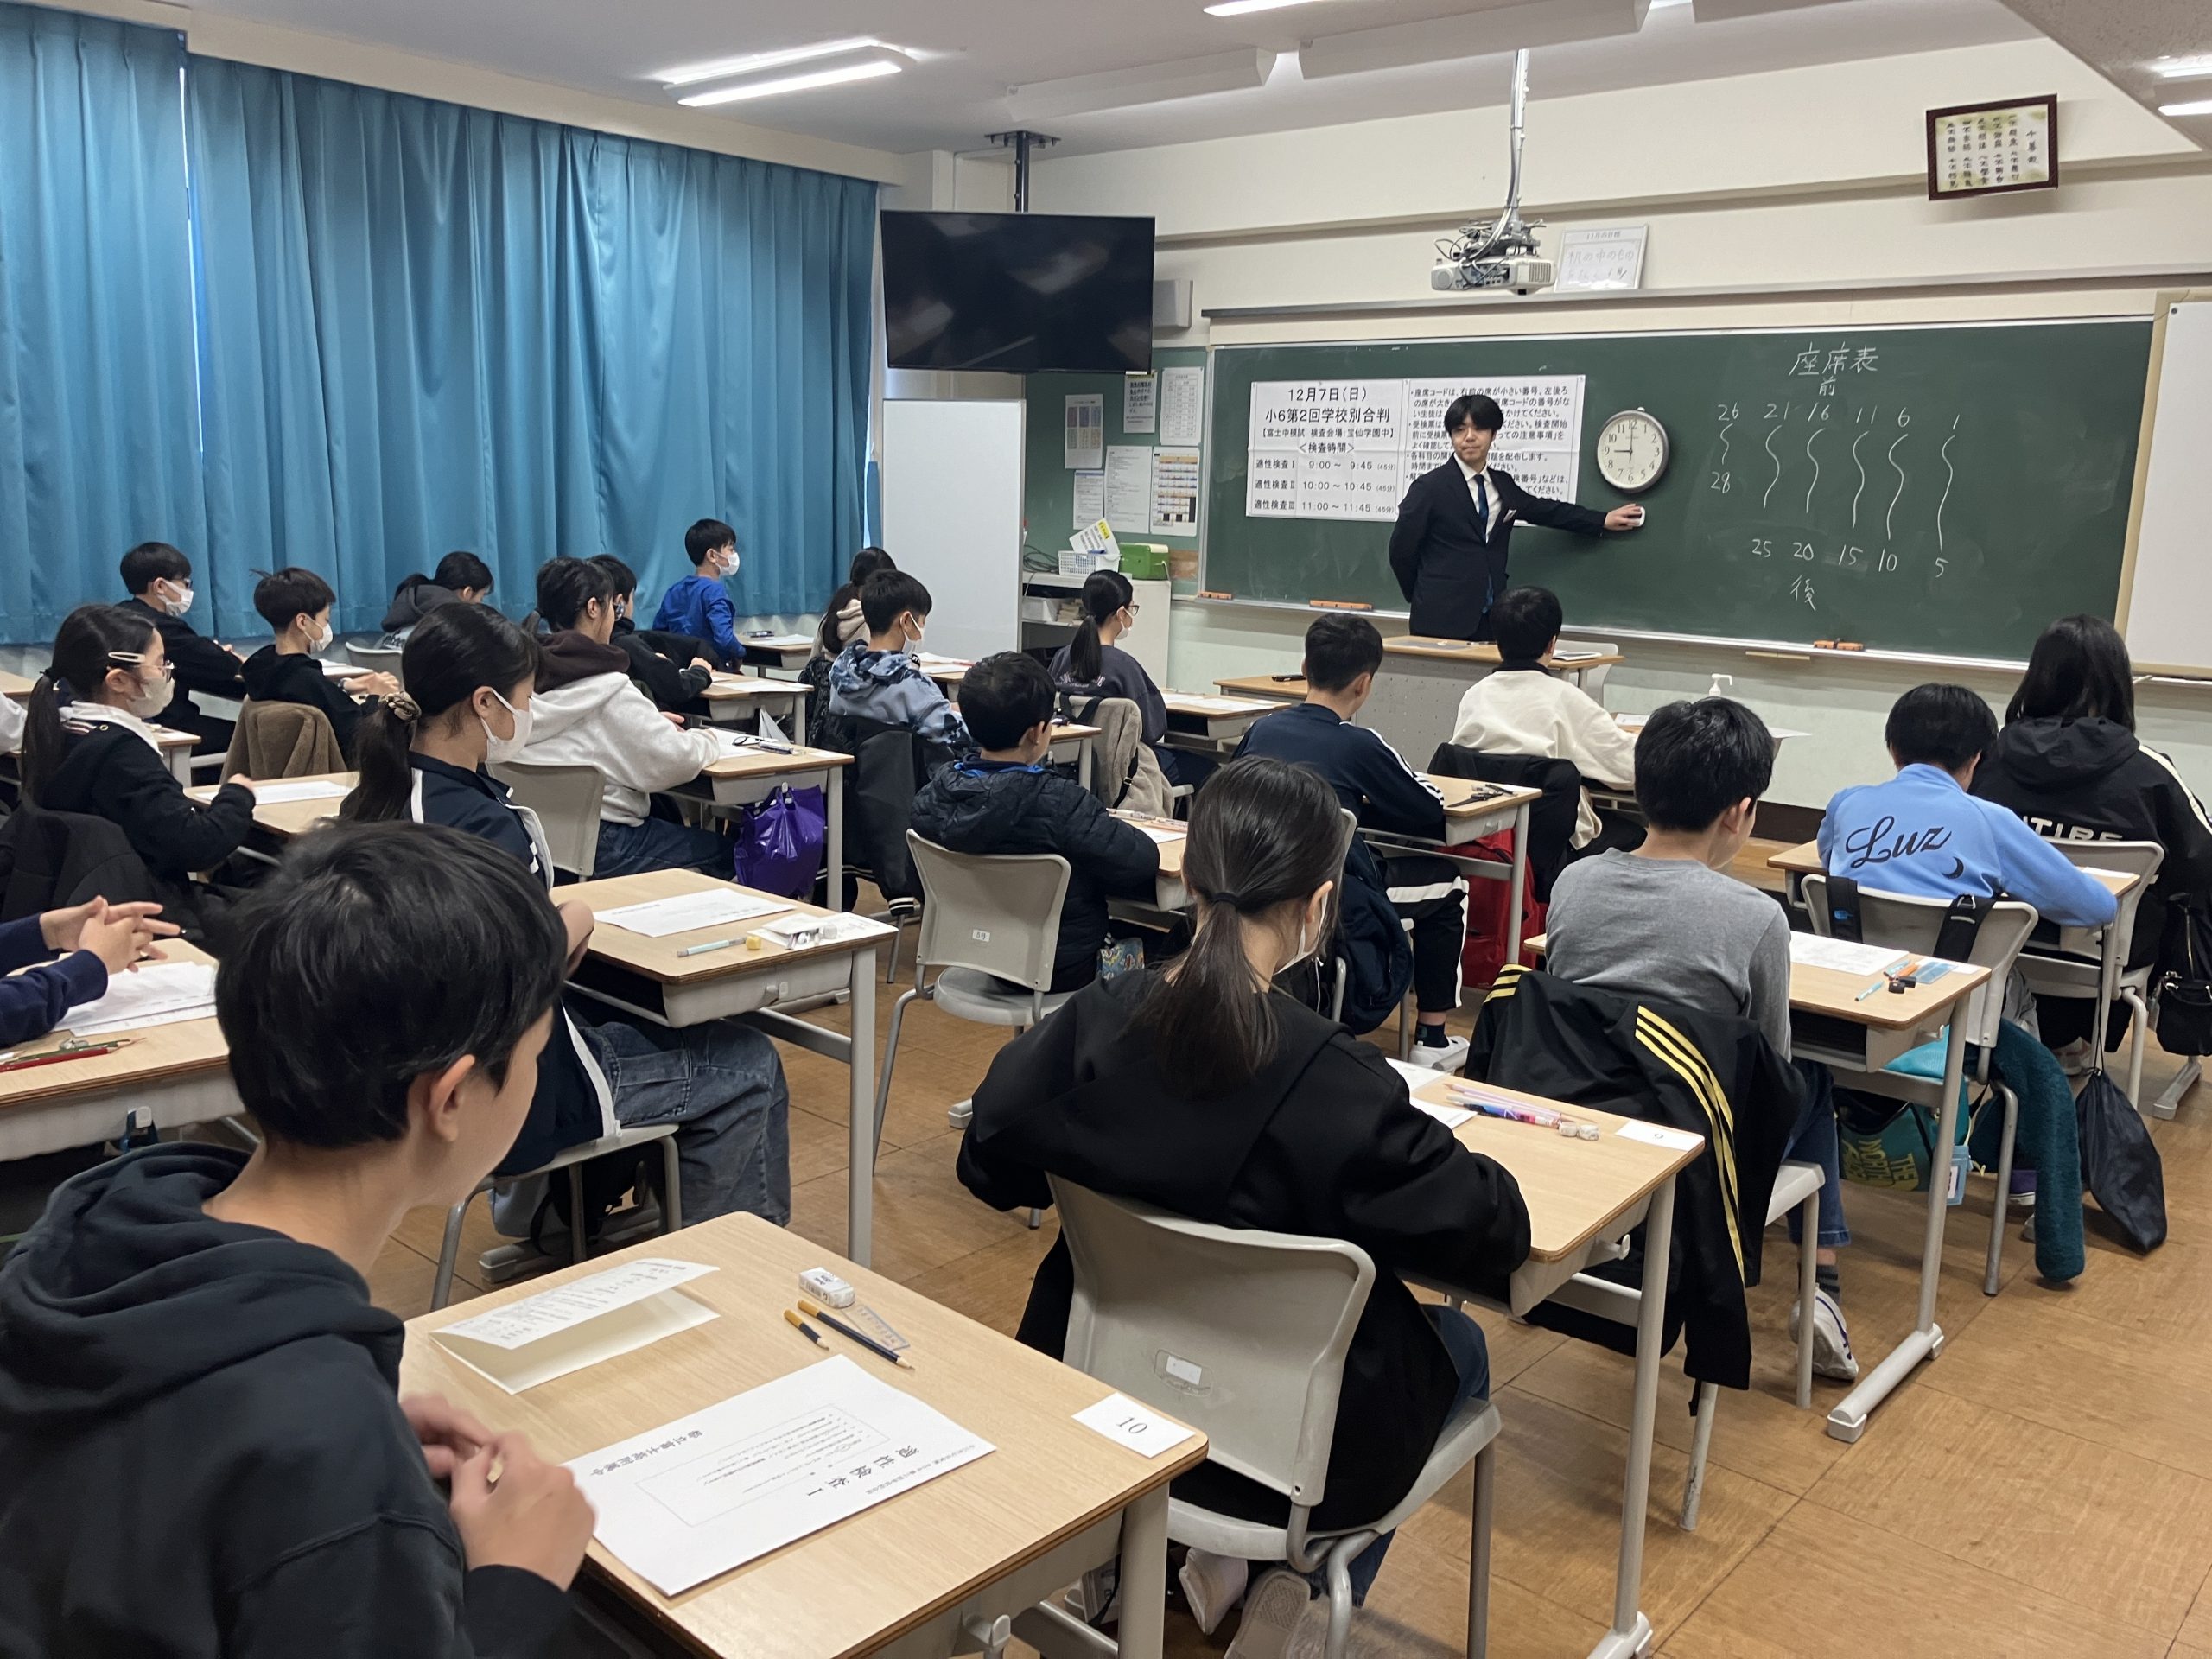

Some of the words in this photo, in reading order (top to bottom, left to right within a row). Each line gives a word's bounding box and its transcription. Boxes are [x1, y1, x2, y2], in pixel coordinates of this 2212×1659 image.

[1789, 340, 1879, 376] 座席表
[1819, 375, 1837, 396] 前
[1288, 386, 1367, 402] 12月7日(日)
[1265, 407, 1389, 423] 小6第2回学校別合判
[1717, 402, 1739, 421] 26
[1763, 401, 1789, 421] 21
[1807, 402, 1830, 422] 16
[1856, 405, 1878, 425] 11
[1897, 406, 1910, 429] 6
[1952, 414, 1961, 430] 1
[1618, 424, 1624, 434] 11
[1628, 419, 1637, 429] 12
[1643, 424, 1648, 434] 1
[1608, 434, 1617, 443] 10
[1651, 434, 1657, 443] 2
[1487, 452, 1548, 462] 題を配布します。
[1308, 461, 1331, 470] 9:00
[1350, 461, 1372, 470] 9:45
[1303, 481, 1330, 490] 10:00
[1344, 482, 1372, 491] 10:45
[1710, 471, 1731, 493] 28
[1302, 502, 1329, 511] 11:00
[1344, 503, 1371, 512] 11:45
[1751, 539, 1773, 558] 25
[1792, 541, 1815, 561] 20
[1838, 543, 1864, 566] 15
[1878, 548, 1898, 572] 10
[1934, 557, 1949, 578] 5
[1789, 574, 1817, 611] 後
[1846, 815, 1952, 868] Luz
[1116, 1416, 1148, 1434] 10
